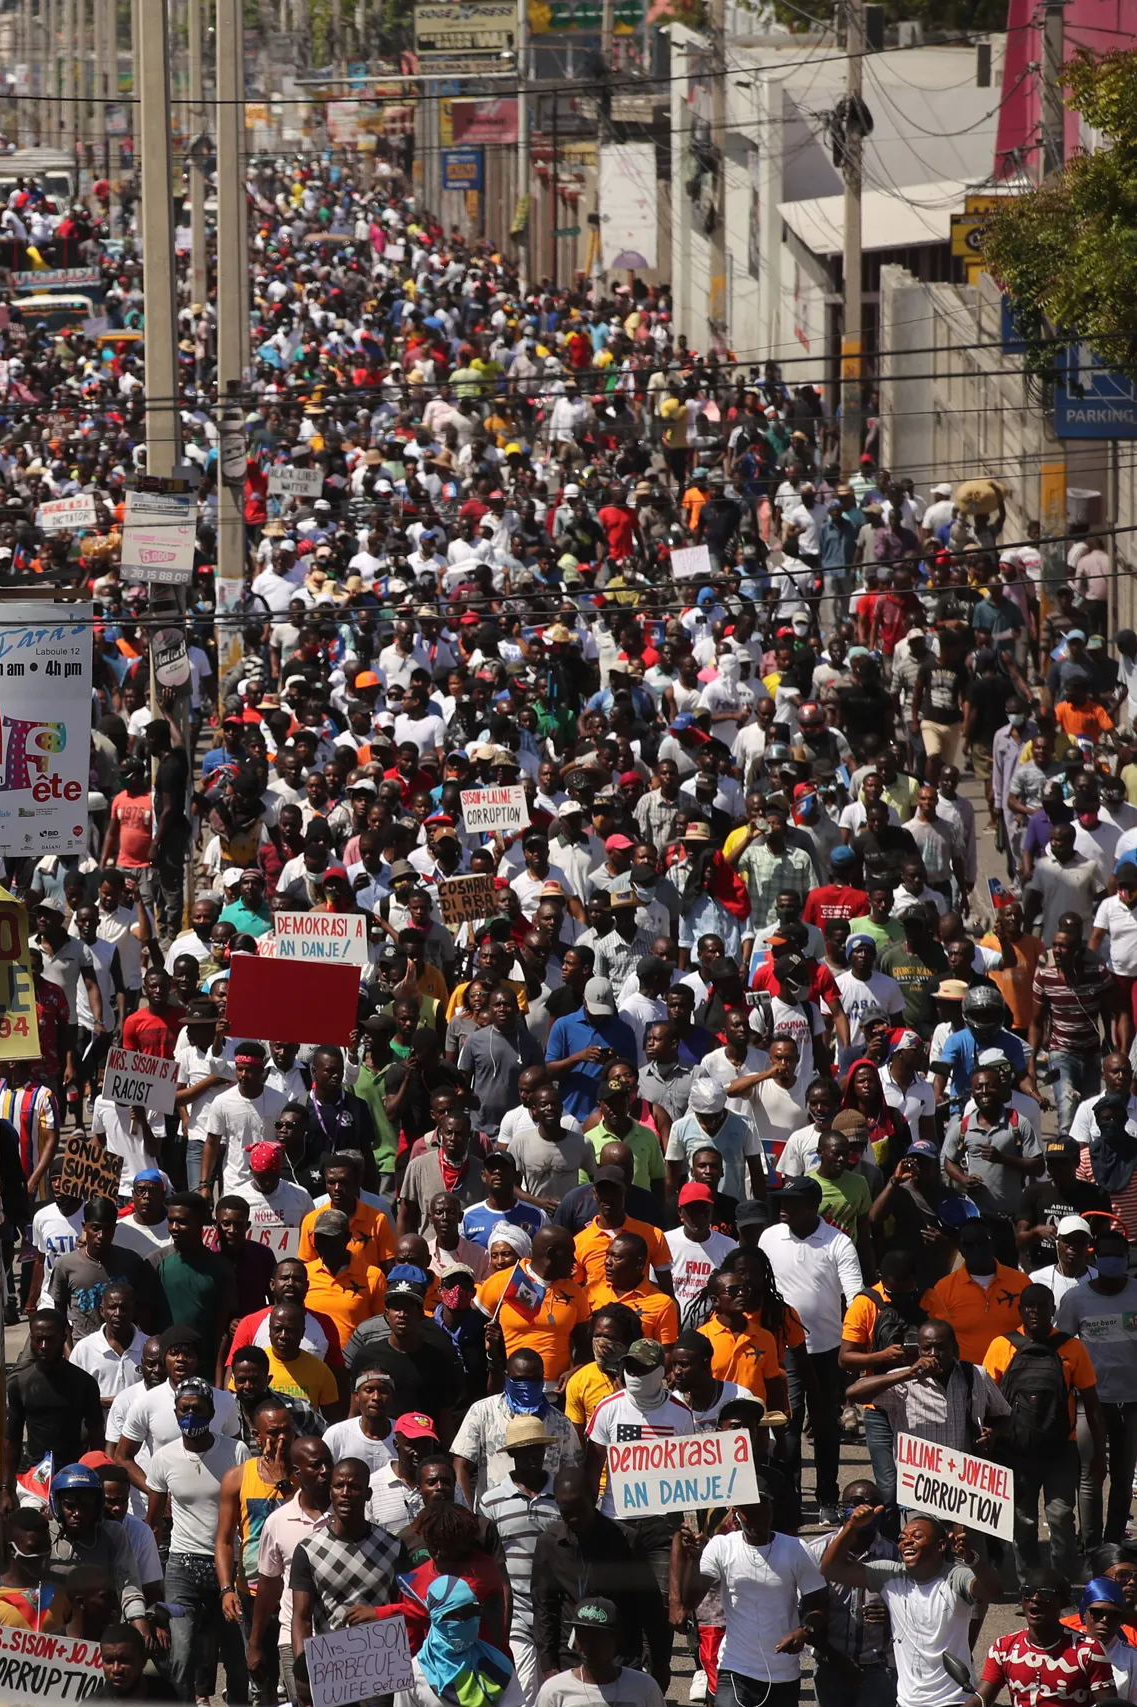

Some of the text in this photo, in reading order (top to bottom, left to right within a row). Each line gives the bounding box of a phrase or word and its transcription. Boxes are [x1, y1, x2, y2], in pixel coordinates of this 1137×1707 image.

[1066, 409, 1135, 423] PARKING
[35, 647, 80, 656] Laboule 12
[6, 663, 25, 676] am
[45, 660, 61, 676] 4h
[64, 662, 82, 678] pm
[467, 807, 522, 825] CORRUPTION
[441, 893, 494, 911] DI ABA
[277, 916, 363, 937] DEMOKRASI A
[280, 939, 295, 956] AN
[851, 999, 877, 1010] ABA
[131, 1054, 159, 1077] SISON
[159, 1060, 169, 1079] IS
[171, 1063, 179, 1083] A
[111, 1075, 153, 1103] RACIST
[67, 1138, 102, 1164] ONU
[254, 1208, 285, 1221] NOU SE
[259, 1229, 289, 1251] IS A
[685, 1260, 711, 1276] FND
[898, 1435, 943, 1473] LALIME
[958, 1457, 1010, 1500] JOVENEL
[623, 1481, 649, 1509] AN
[310, 1637, 347, 1661] Mrs.
[313, 1649, 412, 1686] BARBECUE'S
[372, 1676, 395, 1697] get
